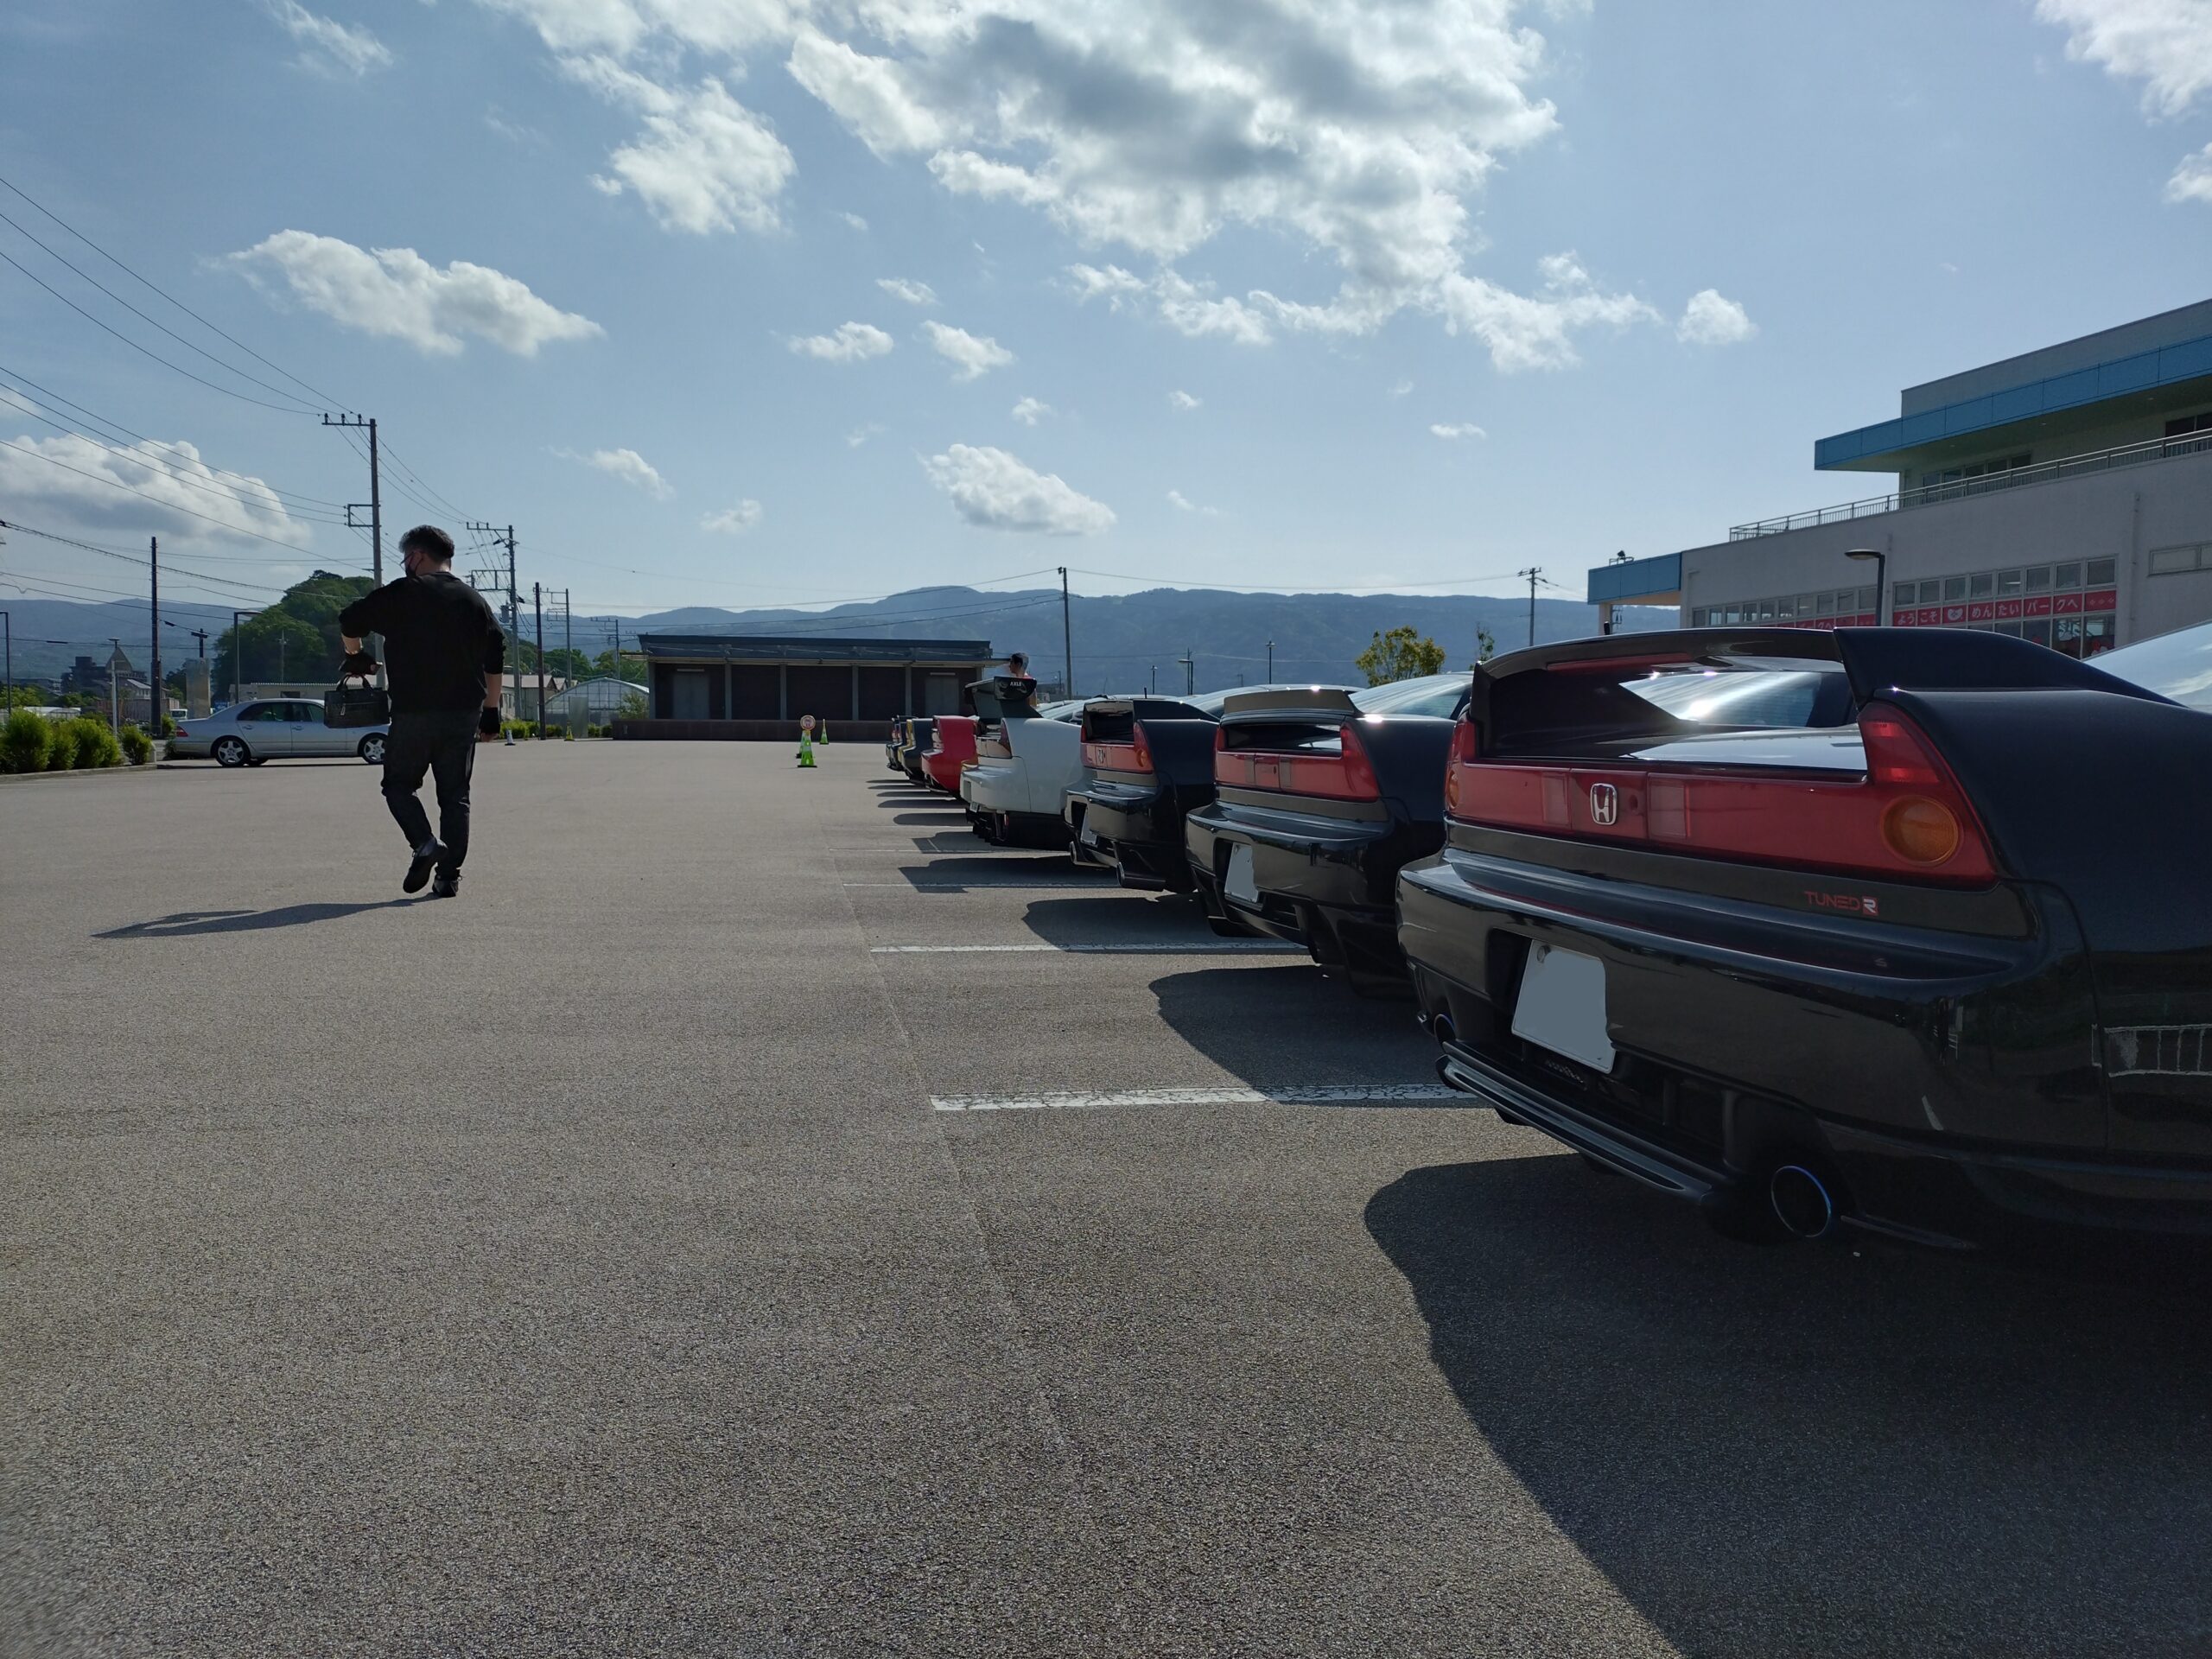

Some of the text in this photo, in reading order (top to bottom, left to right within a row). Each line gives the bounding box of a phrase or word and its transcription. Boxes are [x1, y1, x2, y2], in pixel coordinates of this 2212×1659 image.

[1897, 598, 2079, 625] ようこそ めんたいパークへ
